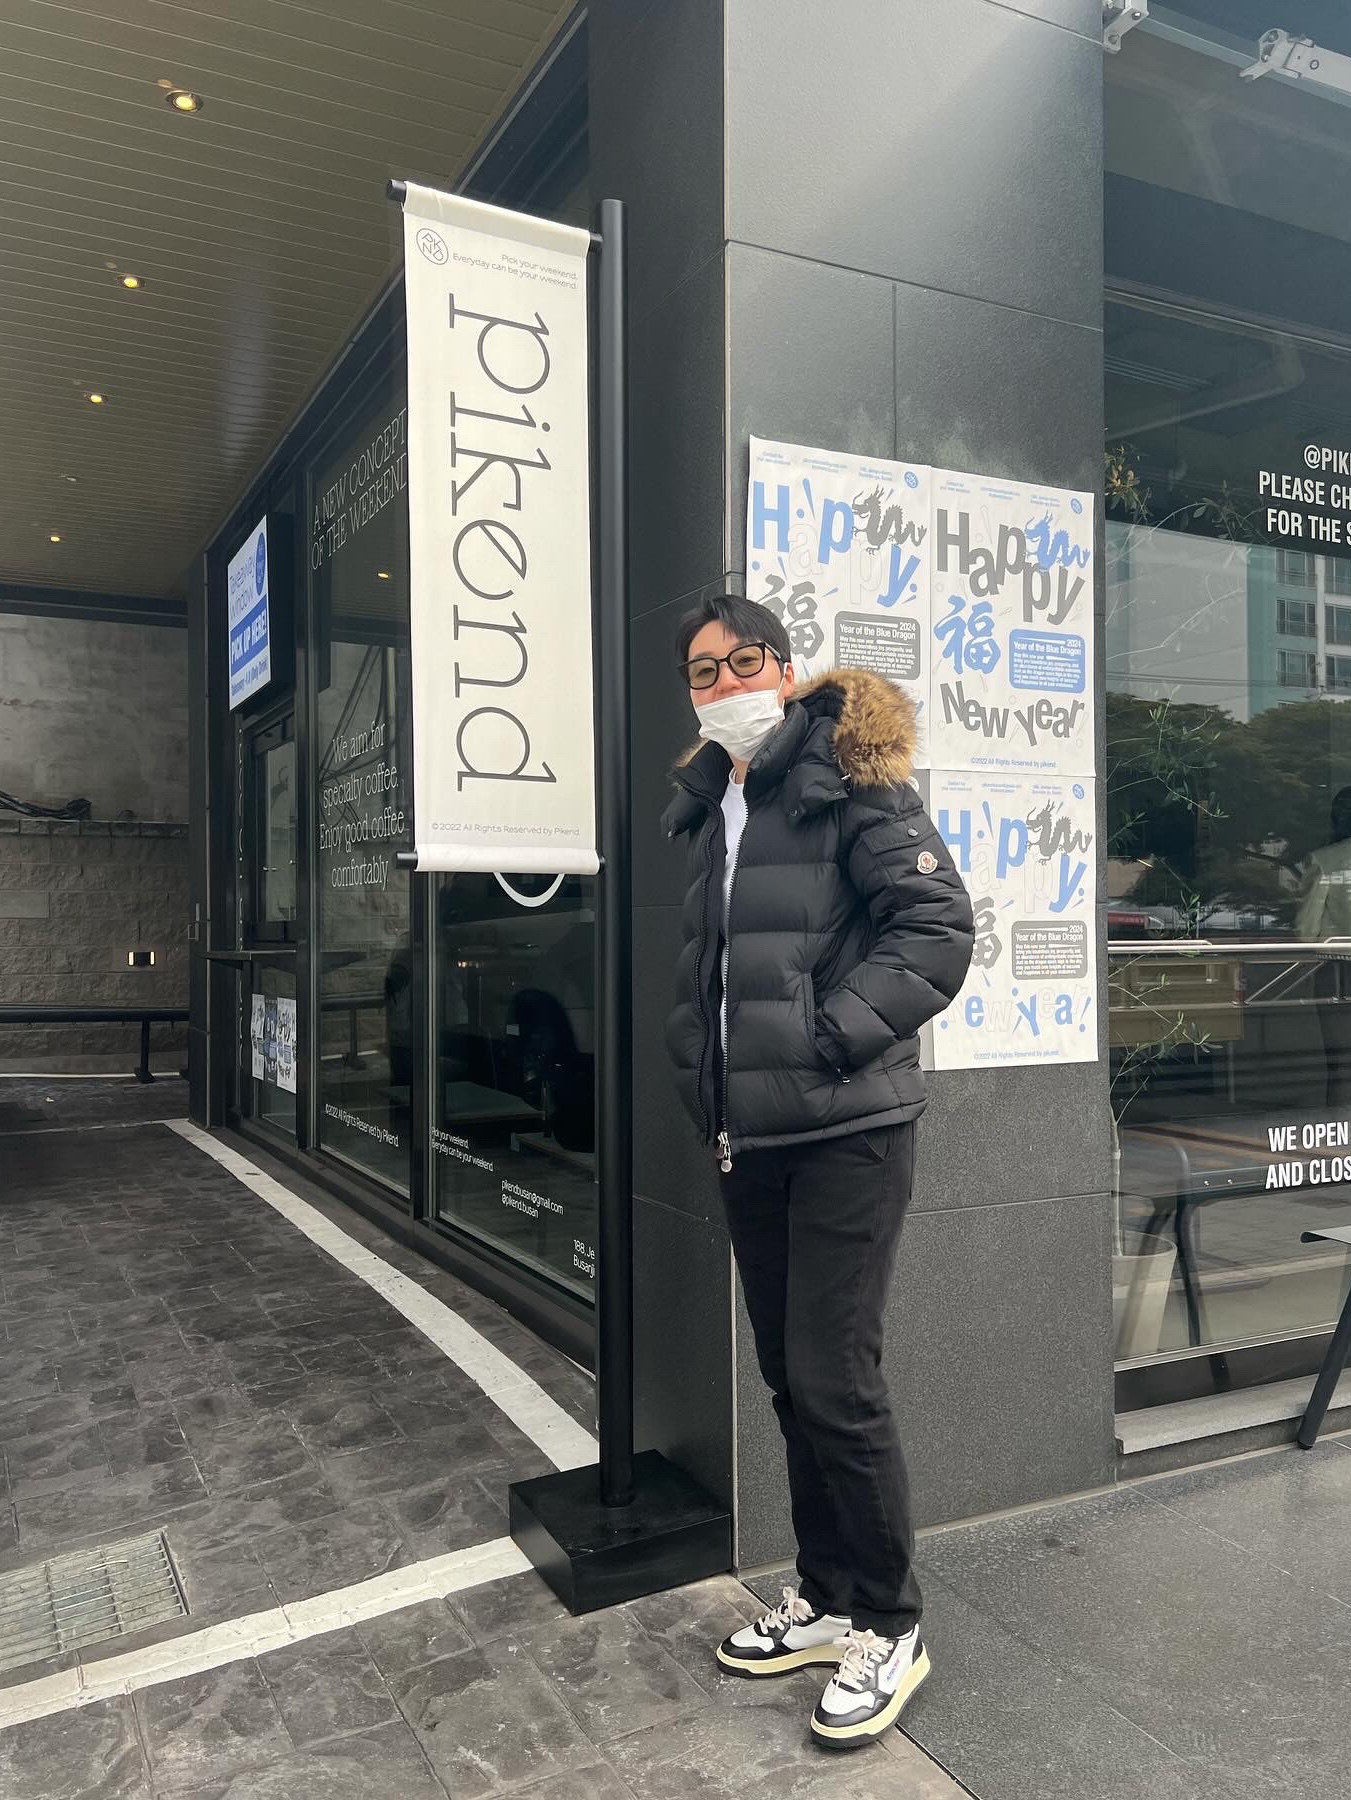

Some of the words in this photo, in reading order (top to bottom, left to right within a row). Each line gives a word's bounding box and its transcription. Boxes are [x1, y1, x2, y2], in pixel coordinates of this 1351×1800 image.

[453, 253, 490, 269] Everyday
[492, 263, 506, 271] can
[508, 265, 518, 275] be
[519, 269, 538, 279] your
[501, 254, 518, 264] Pick
[519, 259, 538, 269] your
[313, 505, 321, 535] A
[322, 472, 347, 525] NEW
[350, 407, 407, 495] CONCEPT
[1304, 444, 1351, 475] @PIK
[1259, 470, 1325, 505] PLEASE
[311, 535, 325, 570] OF
[327, 513, 347, 557] THE
[449, 293, 557, 792] pikend
[1267, 508, 1303, 536] FOR
[1308, 515, 1341, 543] THE
[937, 508, 1085, 625] Happy
[231, 631, 243, 664] PICK
[243, 624, 251, 653] UP
[251, 609, 267, 646] HERE!
[840, 623, 855, 633] Year
[855, 625, 863, 634] of
[864, 626, 875, 636] the
[876, 627, 891, 638] Blue
[892, 629, 916, 640] Dragon
[899, 622, 916, 631] 2024
[933, 594, 1001, 674] 福
[1014, 641, 1027, 650] Year
[1028, 642, 1034, 650] of
[1035, 643, 1045, 652] the
[1046, 644, 1059, 653] Blue
[1060, 646, 1081, 656] Dragon
[940, 680, 1009, 738] New
[332, 735, 348, 764] We
[350, 732, 368, 758] aim
[371, 720, 386, 753] for
[323, 776, 363, 815] specialty
[365, 762, 399, 795] coffee.
[319, 823, 343, 855] Enjoy
[345, 813, 368, 852] good
[371, 806, 405, 839] coffee
[463, 823, 473, 831] All
[475, 825, 502, 833] Rights
[503, 825, 542, 834] Reserved
[543, 827, 553, 836] by
[1015, 932, 1029, 941] Year
[1030, 932, 1036, 941] of
[1037, 933, 1047, 941] the
[1048, 932, 1061, 940] Blue
[1062, 932, 1084, 942] Dragon
[1069, 925, 1083, 933] 2024
[377, 1126, 383, 1142] by
[1268, 1125, 1297, 1152] WE
[1302, 1121, 1349, 1149] OPEN
[1265, 1161, 1303, 1189] AND
[501, 1179, 564, 1215] pikendbusan@gmail.com
